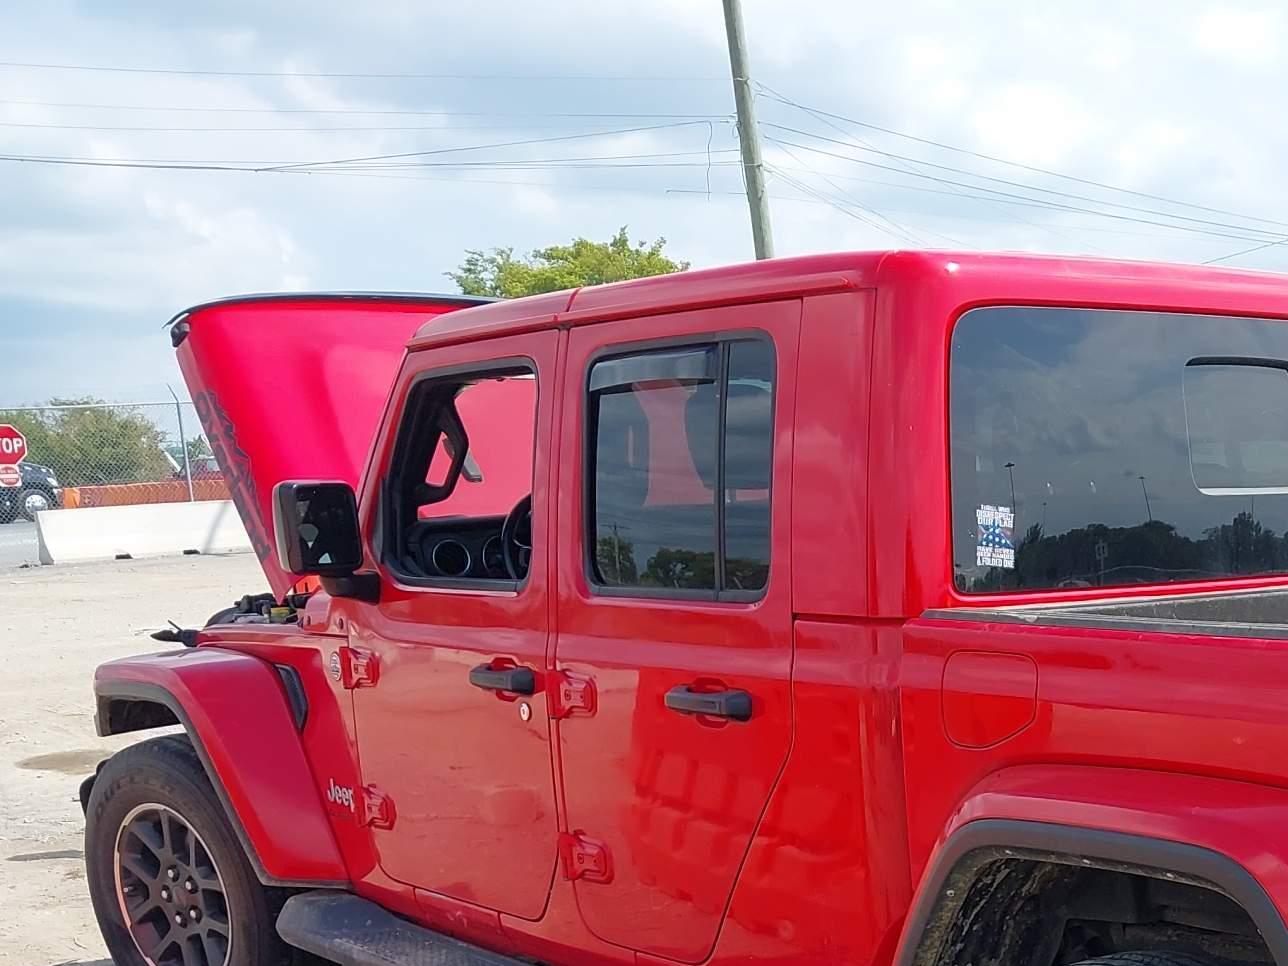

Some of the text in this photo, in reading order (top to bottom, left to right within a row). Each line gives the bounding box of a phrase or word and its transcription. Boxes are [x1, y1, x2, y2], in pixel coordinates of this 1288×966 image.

[977, 517, 1013, 528] OUR FLAG
[982, 556, 1003, 567] FOLDED
[1003, 559, 1014, 568] ONE
[327, 777, 356, 813] Jeep
